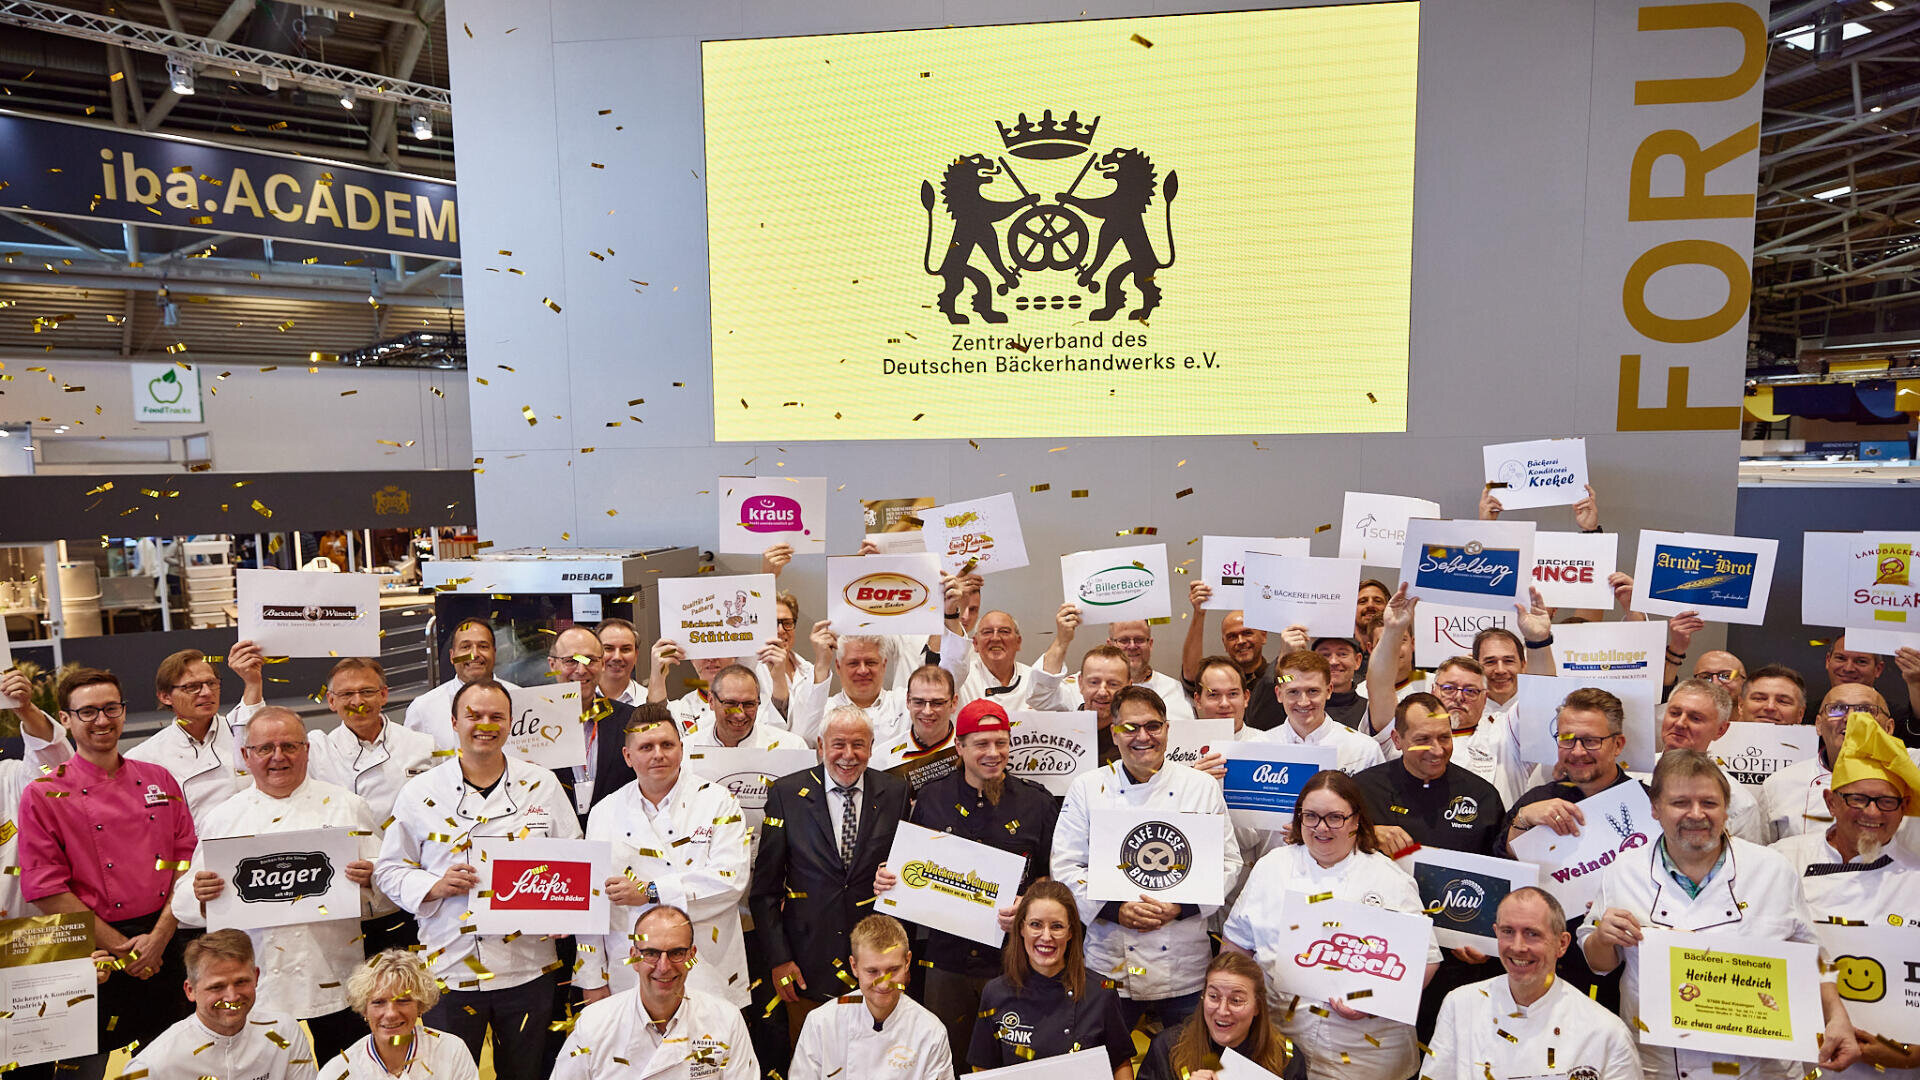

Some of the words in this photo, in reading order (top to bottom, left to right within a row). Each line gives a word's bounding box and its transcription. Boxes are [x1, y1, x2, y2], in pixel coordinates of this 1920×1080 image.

[951, 331, 1104, 353] Zentralverband
[1112, 330, 1148, 348] des
[882, 355, 988, 376] Deutschen
[996, 352, 1176, 374] Bäckerhandwerks
[1183, 352, 1221, 370] e.V.
[1527, 458, 1559, 468] Bäckerei
[1528, 466, 1568, 476] Konditorei
[1529, 473, 1575, 488] Krekel
[749, 507, 795, 521] kraus
[569, 573, 606, 581] DEBAG
[1222, 560, 1245, 576] st
[1419, 554, 1513, 587] Seßelberg
[856, 586, 913, 602] Bors
[681, 619, 724, 629] Bäckerei
[1564, 649, 1648, 663] Traublinger
[1006, 755, 1071, 773] Schöder
[1252, 764, 1289, 785] Bals
[1444, 802, 1477, 820] Nau
[1127, 824, 1154, 851] CAFÉ
[1156, 826, 1185, 852] LIESE
[1550, 849, 1617, 884] Weindl
[248, 867, 322, 891] Rager
[495, 868, 570, 902] Schäfer
[1128, 866, 1183, 888] BACKHAUS
[1429, 888, 1483, 915] Nau
[1683, 952, 1724, 964] Bäckerei
[1731, 958, 1772, 969] Stehcafé
[1685, 968, 1727, 984] Heribert
[1731, 973, 1772, 989] Hedrich
[1673, 1016, 1688, 1027] Die
[1690, 1019, 1713, 1030] etwas
[1715, 1021, 1743, 1033] andere
[1745, 1024, 1790, 1037] Bäckerei...
